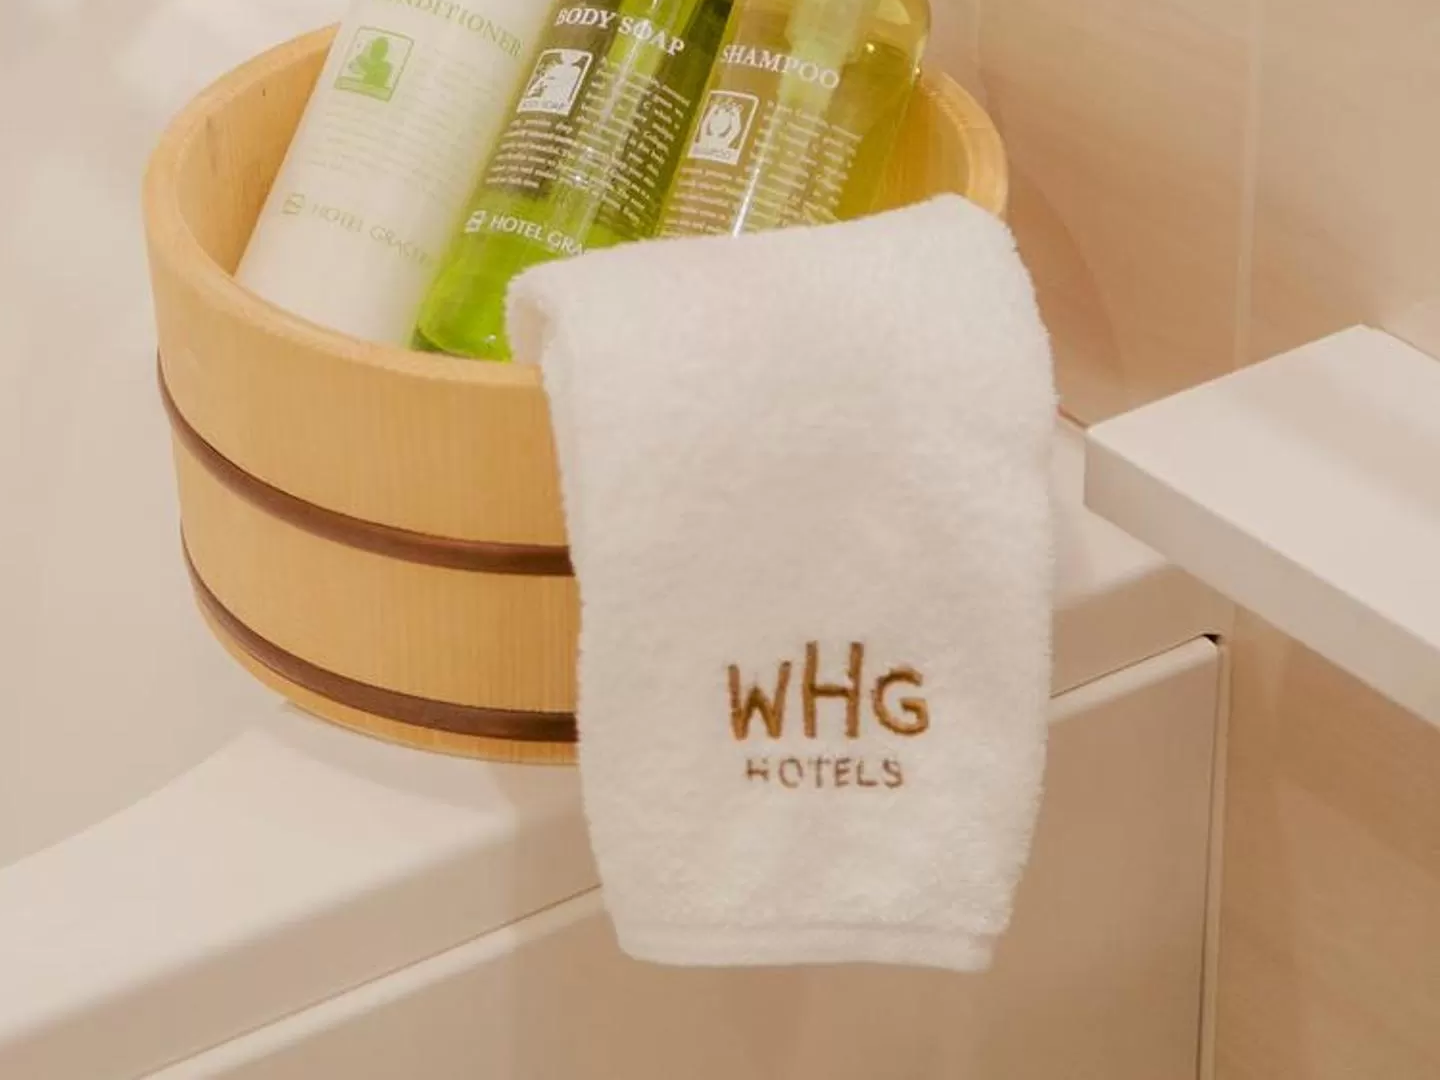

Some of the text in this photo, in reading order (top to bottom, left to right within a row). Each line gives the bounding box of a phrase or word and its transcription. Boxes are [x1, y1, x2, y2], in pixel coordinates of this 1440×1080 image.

[553, 7, 686, 57] BODY SOAP
[721, 44, 840, 89] SHAMPOO
[310, 202, 364, 234] HOTEL
[489, 214, 544, 242] HOTEL
[727, 639, 931, 741] WHG
[745, 756, 905, 790] HOTELS
